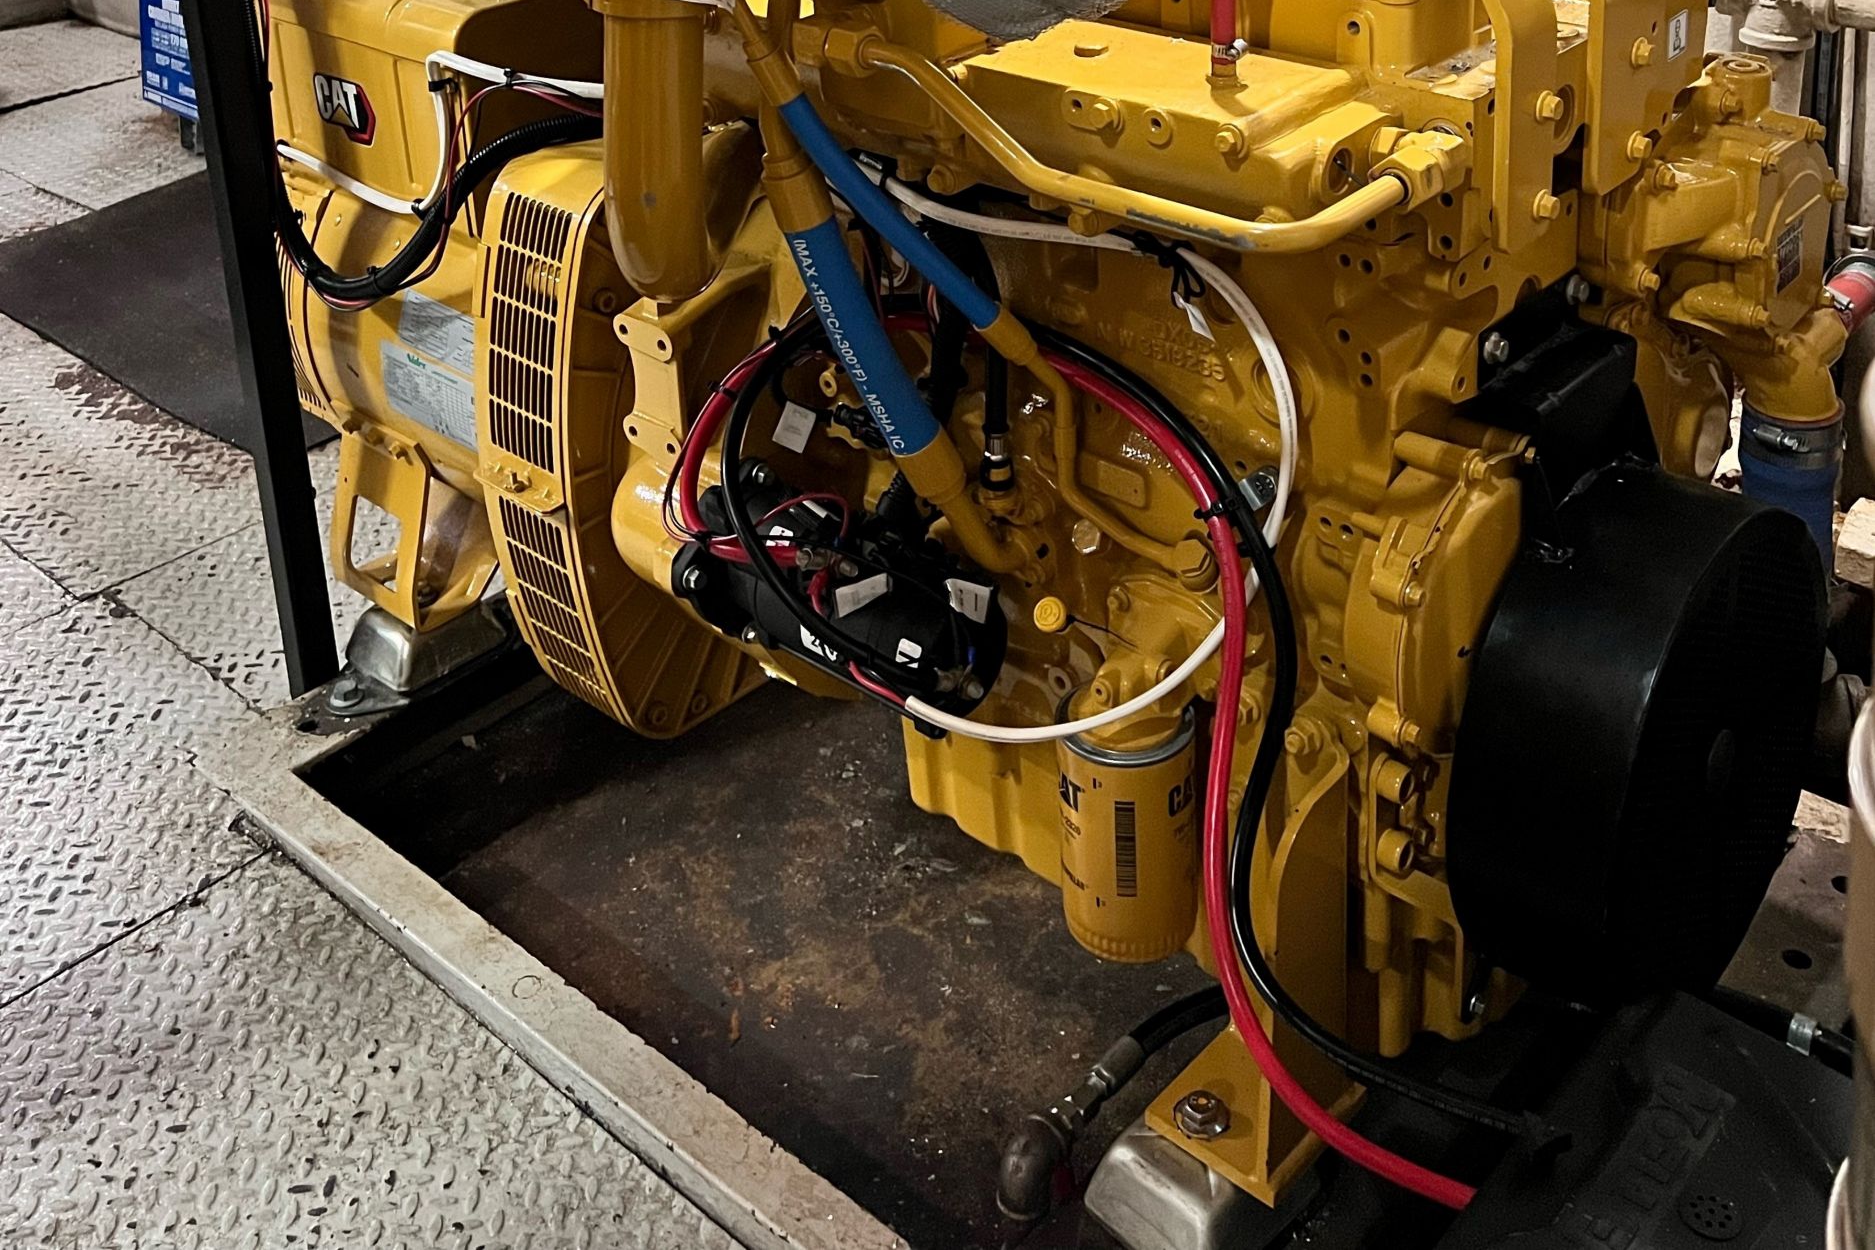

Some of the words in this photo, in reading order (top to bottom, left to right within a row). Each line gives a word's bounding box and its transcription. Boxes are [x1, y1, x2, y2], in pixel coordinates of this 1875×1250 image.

[315, 75, 360, 129] CAT
[865, 393, 895, 433] MSHA
[1058, 771, 1080, 813] AT
[1168, 774, 1194, 818] CA
